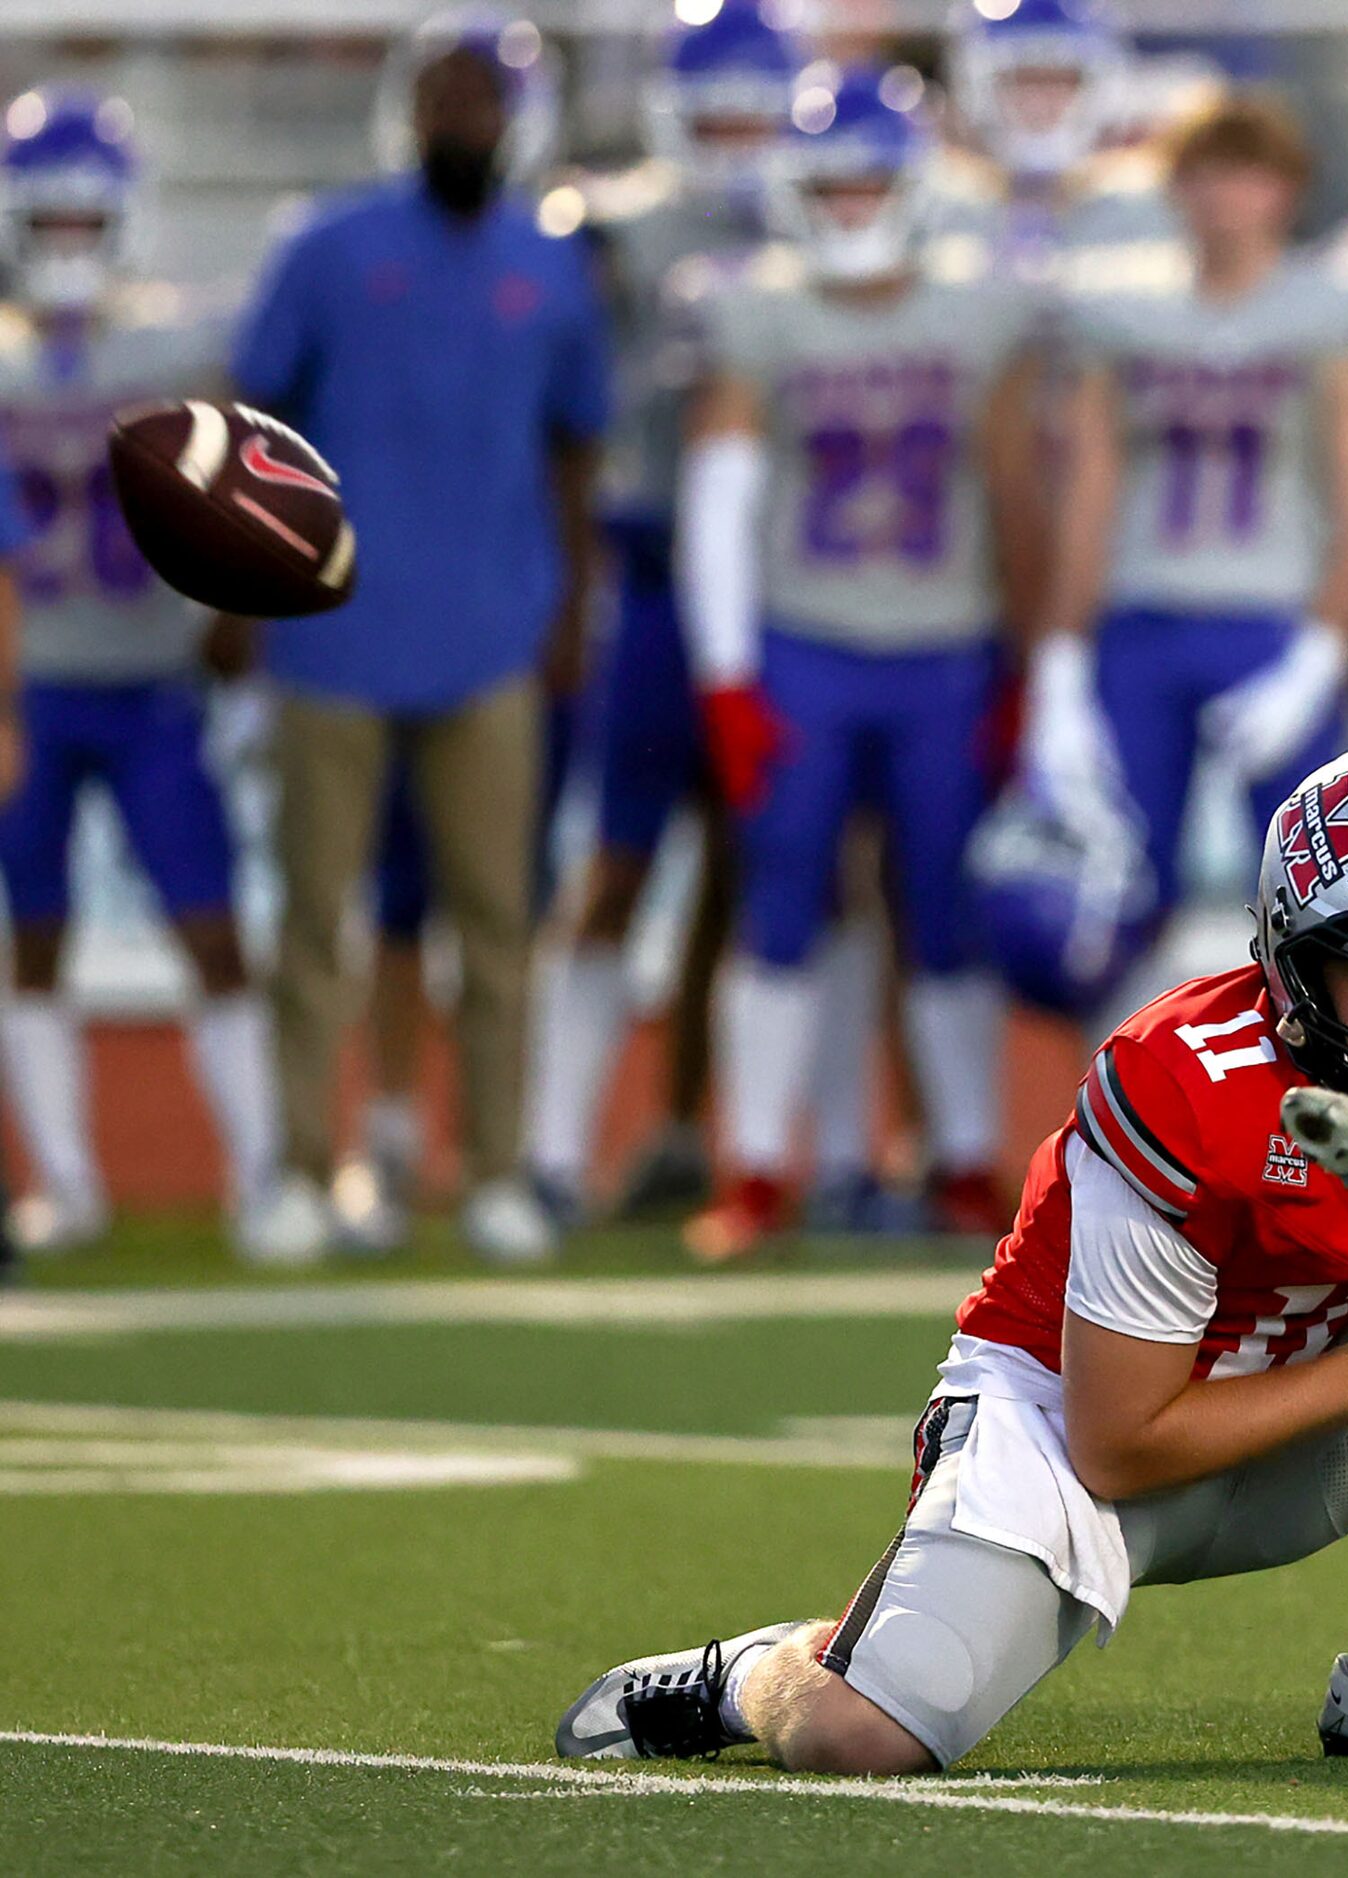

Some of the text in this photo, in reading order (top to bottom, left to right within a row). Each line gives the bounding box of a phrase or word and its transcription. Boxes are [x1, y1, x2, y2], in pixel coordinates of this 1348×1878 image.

[1305, 787, 1338, 881] marcus
[1173, 1009, 1277, 1083] 11
[1269, 1154, 1305, 1168] marcus
